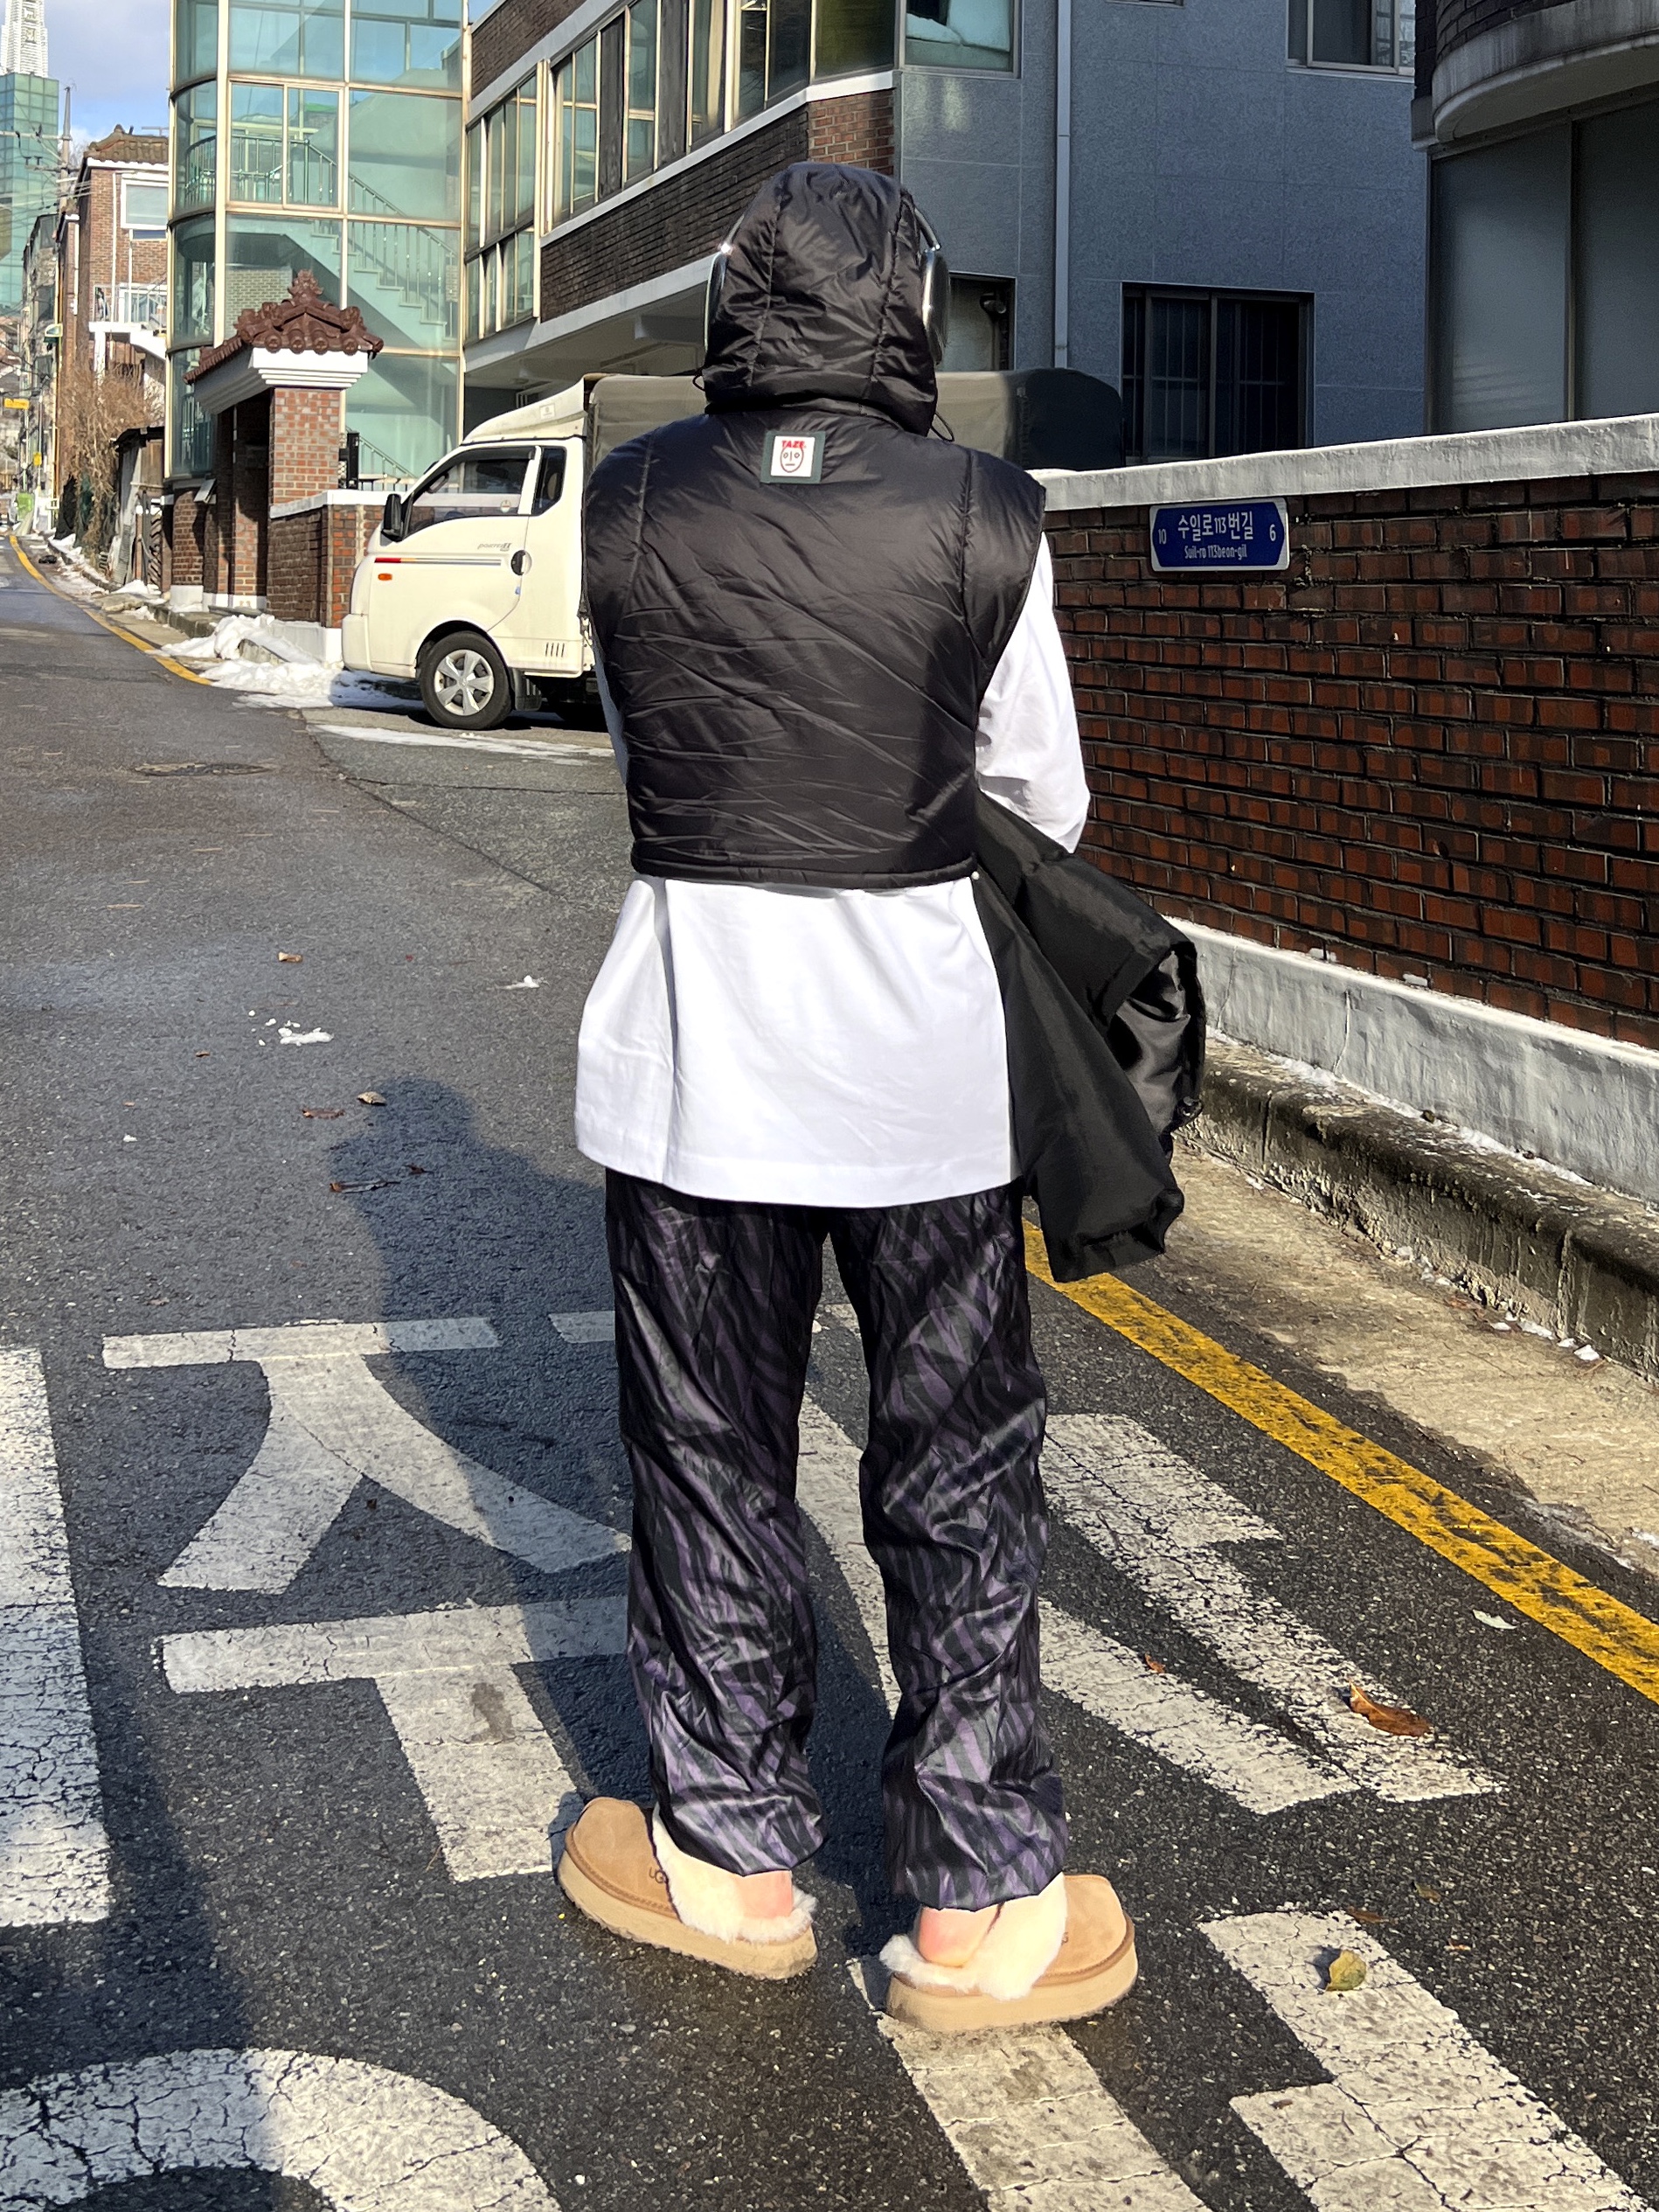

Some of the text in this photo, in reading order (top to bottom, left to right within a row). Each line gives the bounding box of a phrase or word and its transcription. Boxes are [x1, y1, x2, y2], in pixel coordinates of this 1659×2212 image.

[1157, 511, 1276, 545] 10 수일로113번길 6
[1184, 544, 1248, 560] Suil-ro 113beon-gil
